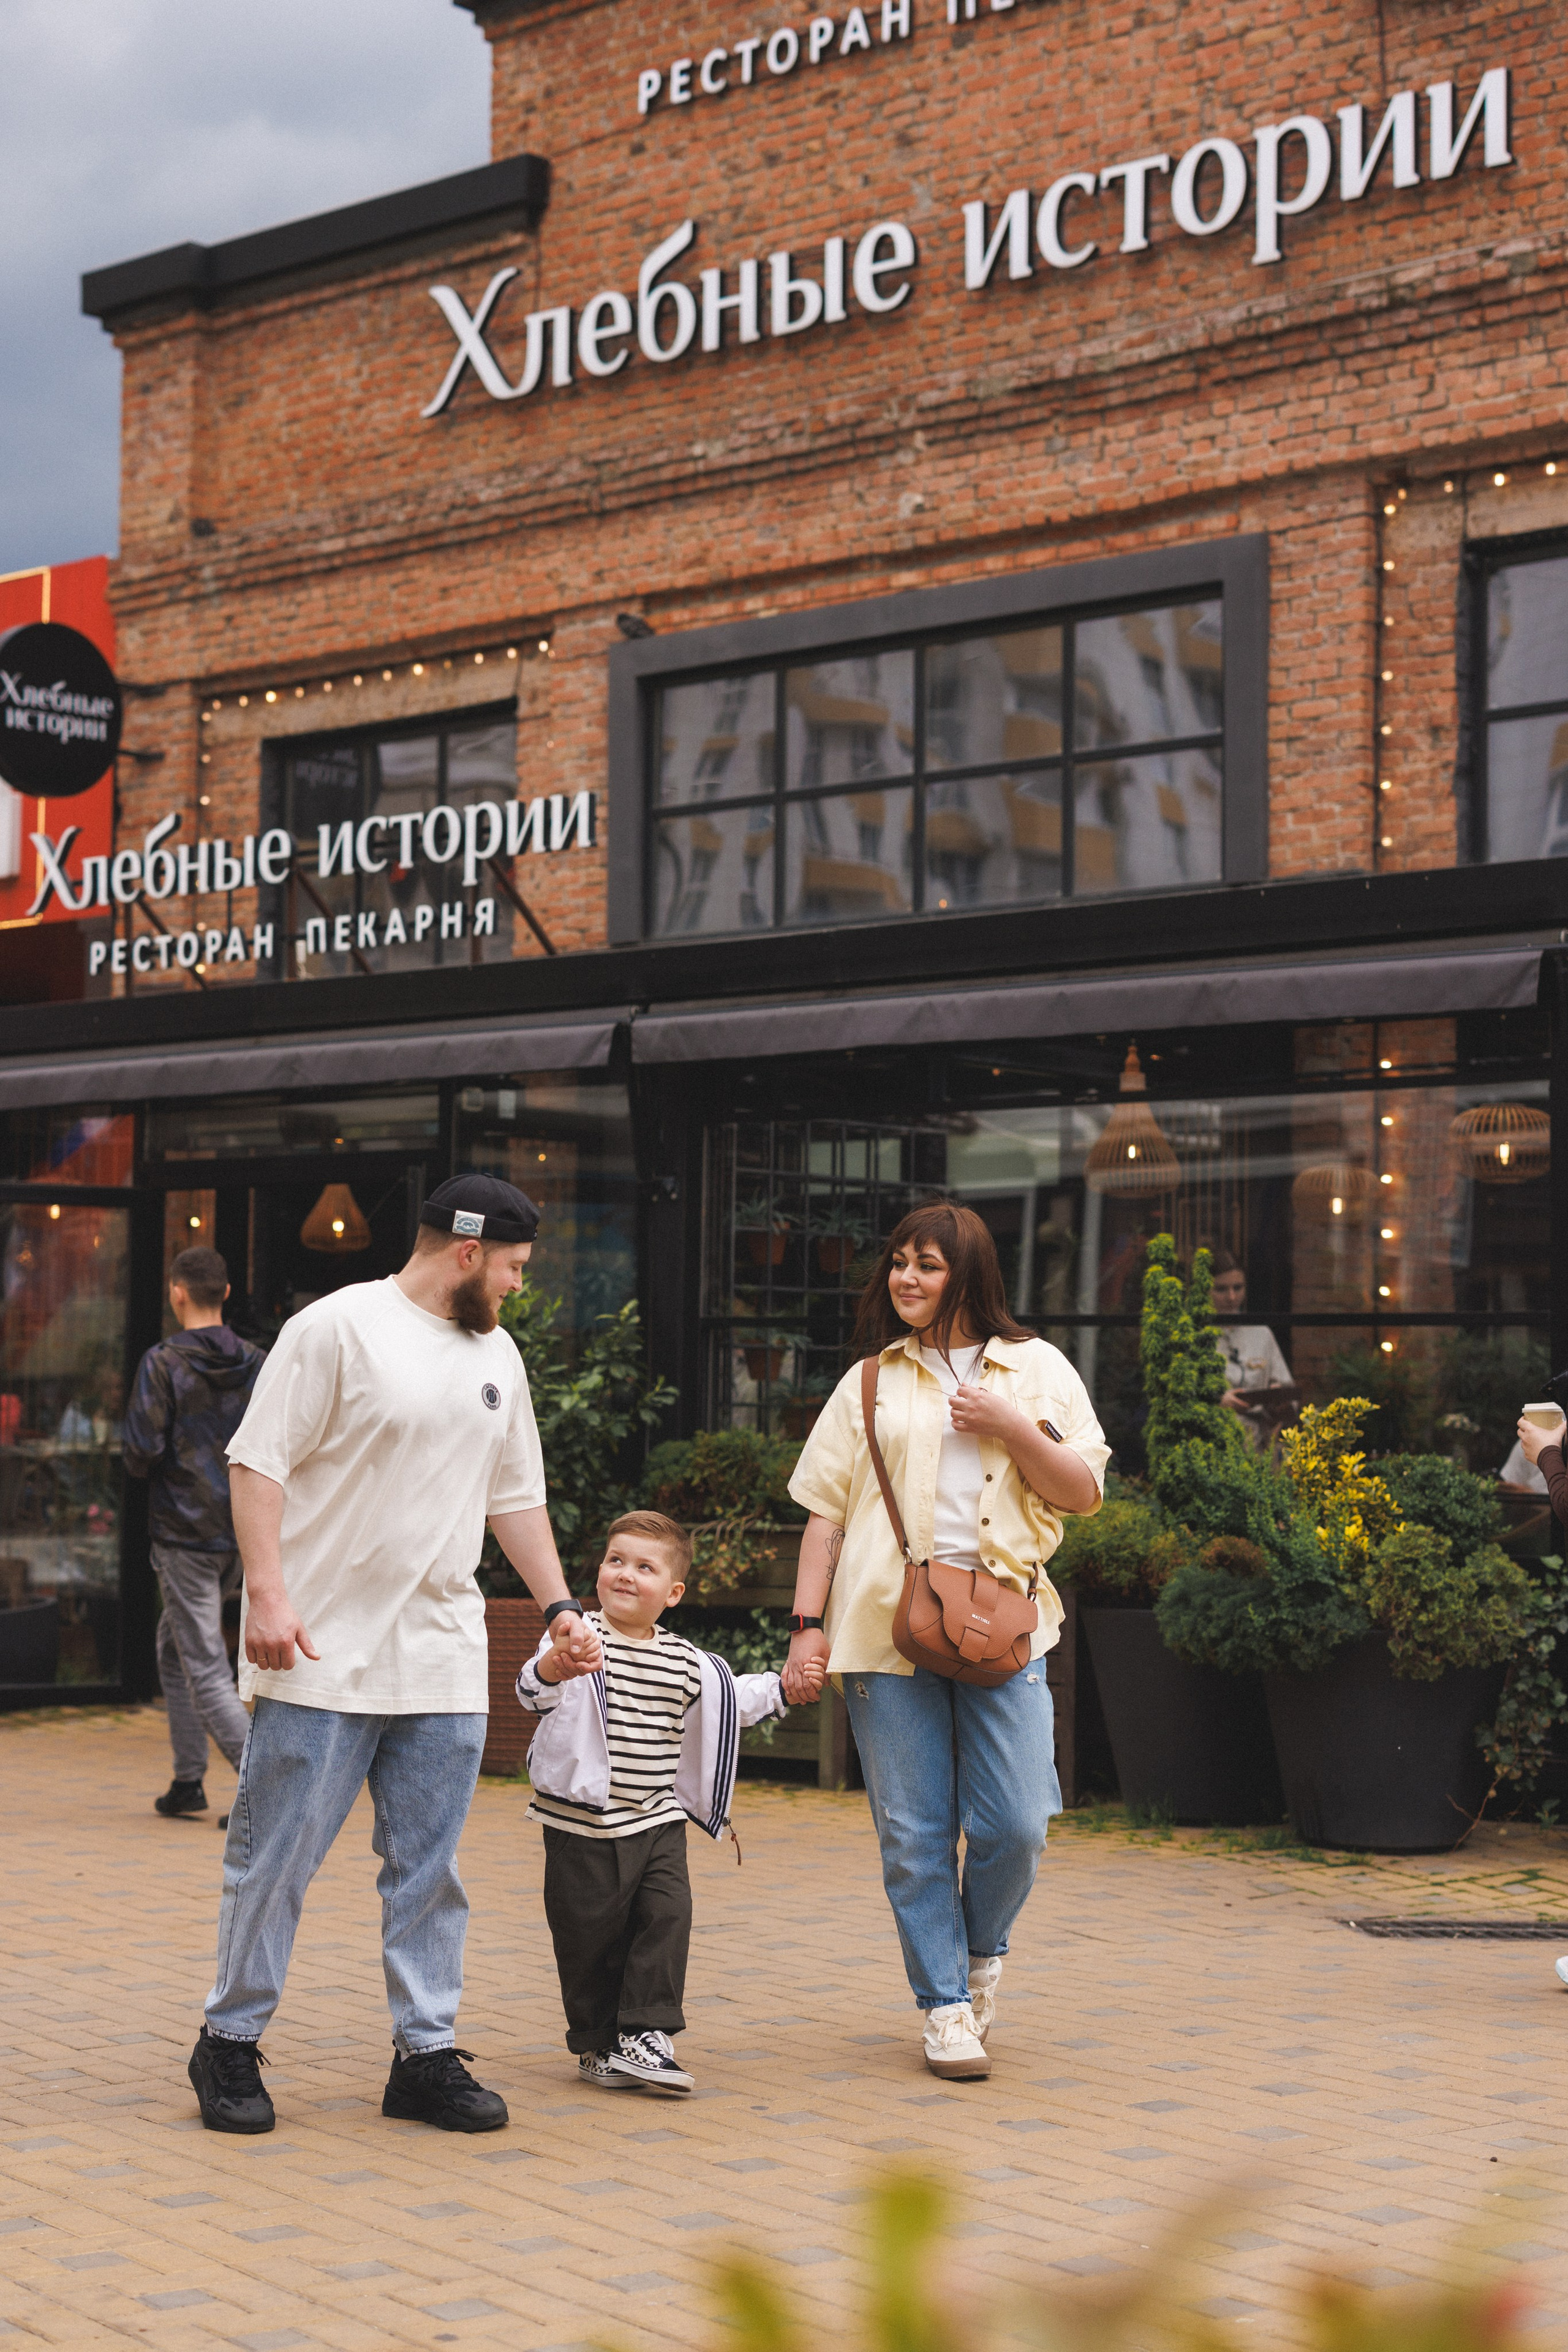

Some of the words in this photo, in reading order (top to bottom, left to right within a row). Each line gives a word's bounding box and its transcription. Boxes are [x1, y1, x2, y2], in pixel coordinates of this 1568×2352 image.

[637, 0, 910, 114] РЕСТОРАН
[420, 219, 914, 418] Хлебные
[961, 67, 1513, 290] истории
[0, 669, 115, 720] Хлебные
[6, 706, 108, 745] истории
[26, 812, 292, 915] Хлебные
[318, 790, 595, 886] истории
[89, 922, 274, 975] РЕСТОРАН
[306, 898, 495, 954] ПЕКАРНЯ
[971, 1613, 990, 1625] MATTIOLI
